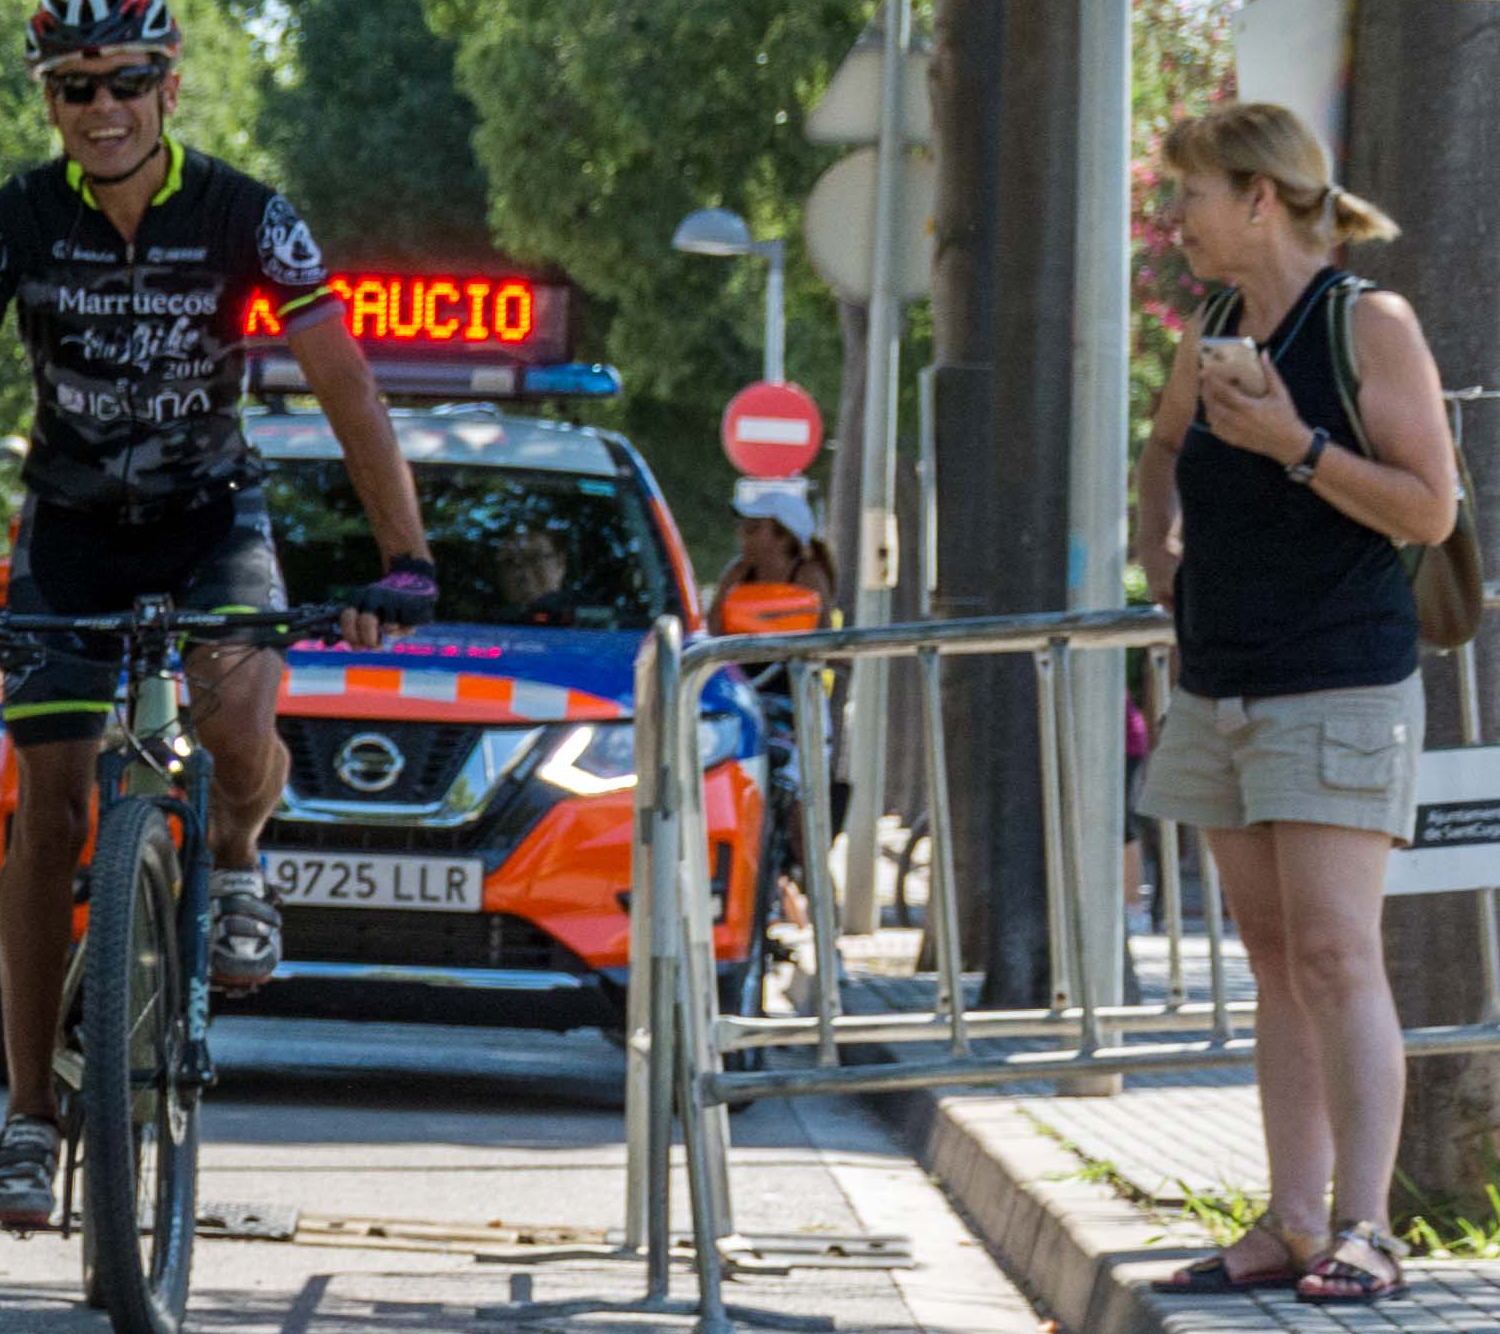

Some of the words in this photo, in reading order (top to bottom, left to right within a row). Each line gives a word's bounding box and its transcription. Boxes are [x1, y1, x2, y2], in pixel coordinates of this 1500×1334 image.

[59, 285, 218, 316] Marruecos
[277, 859, 377, 899] 9725
[393, 862, 468, 903] LLR
